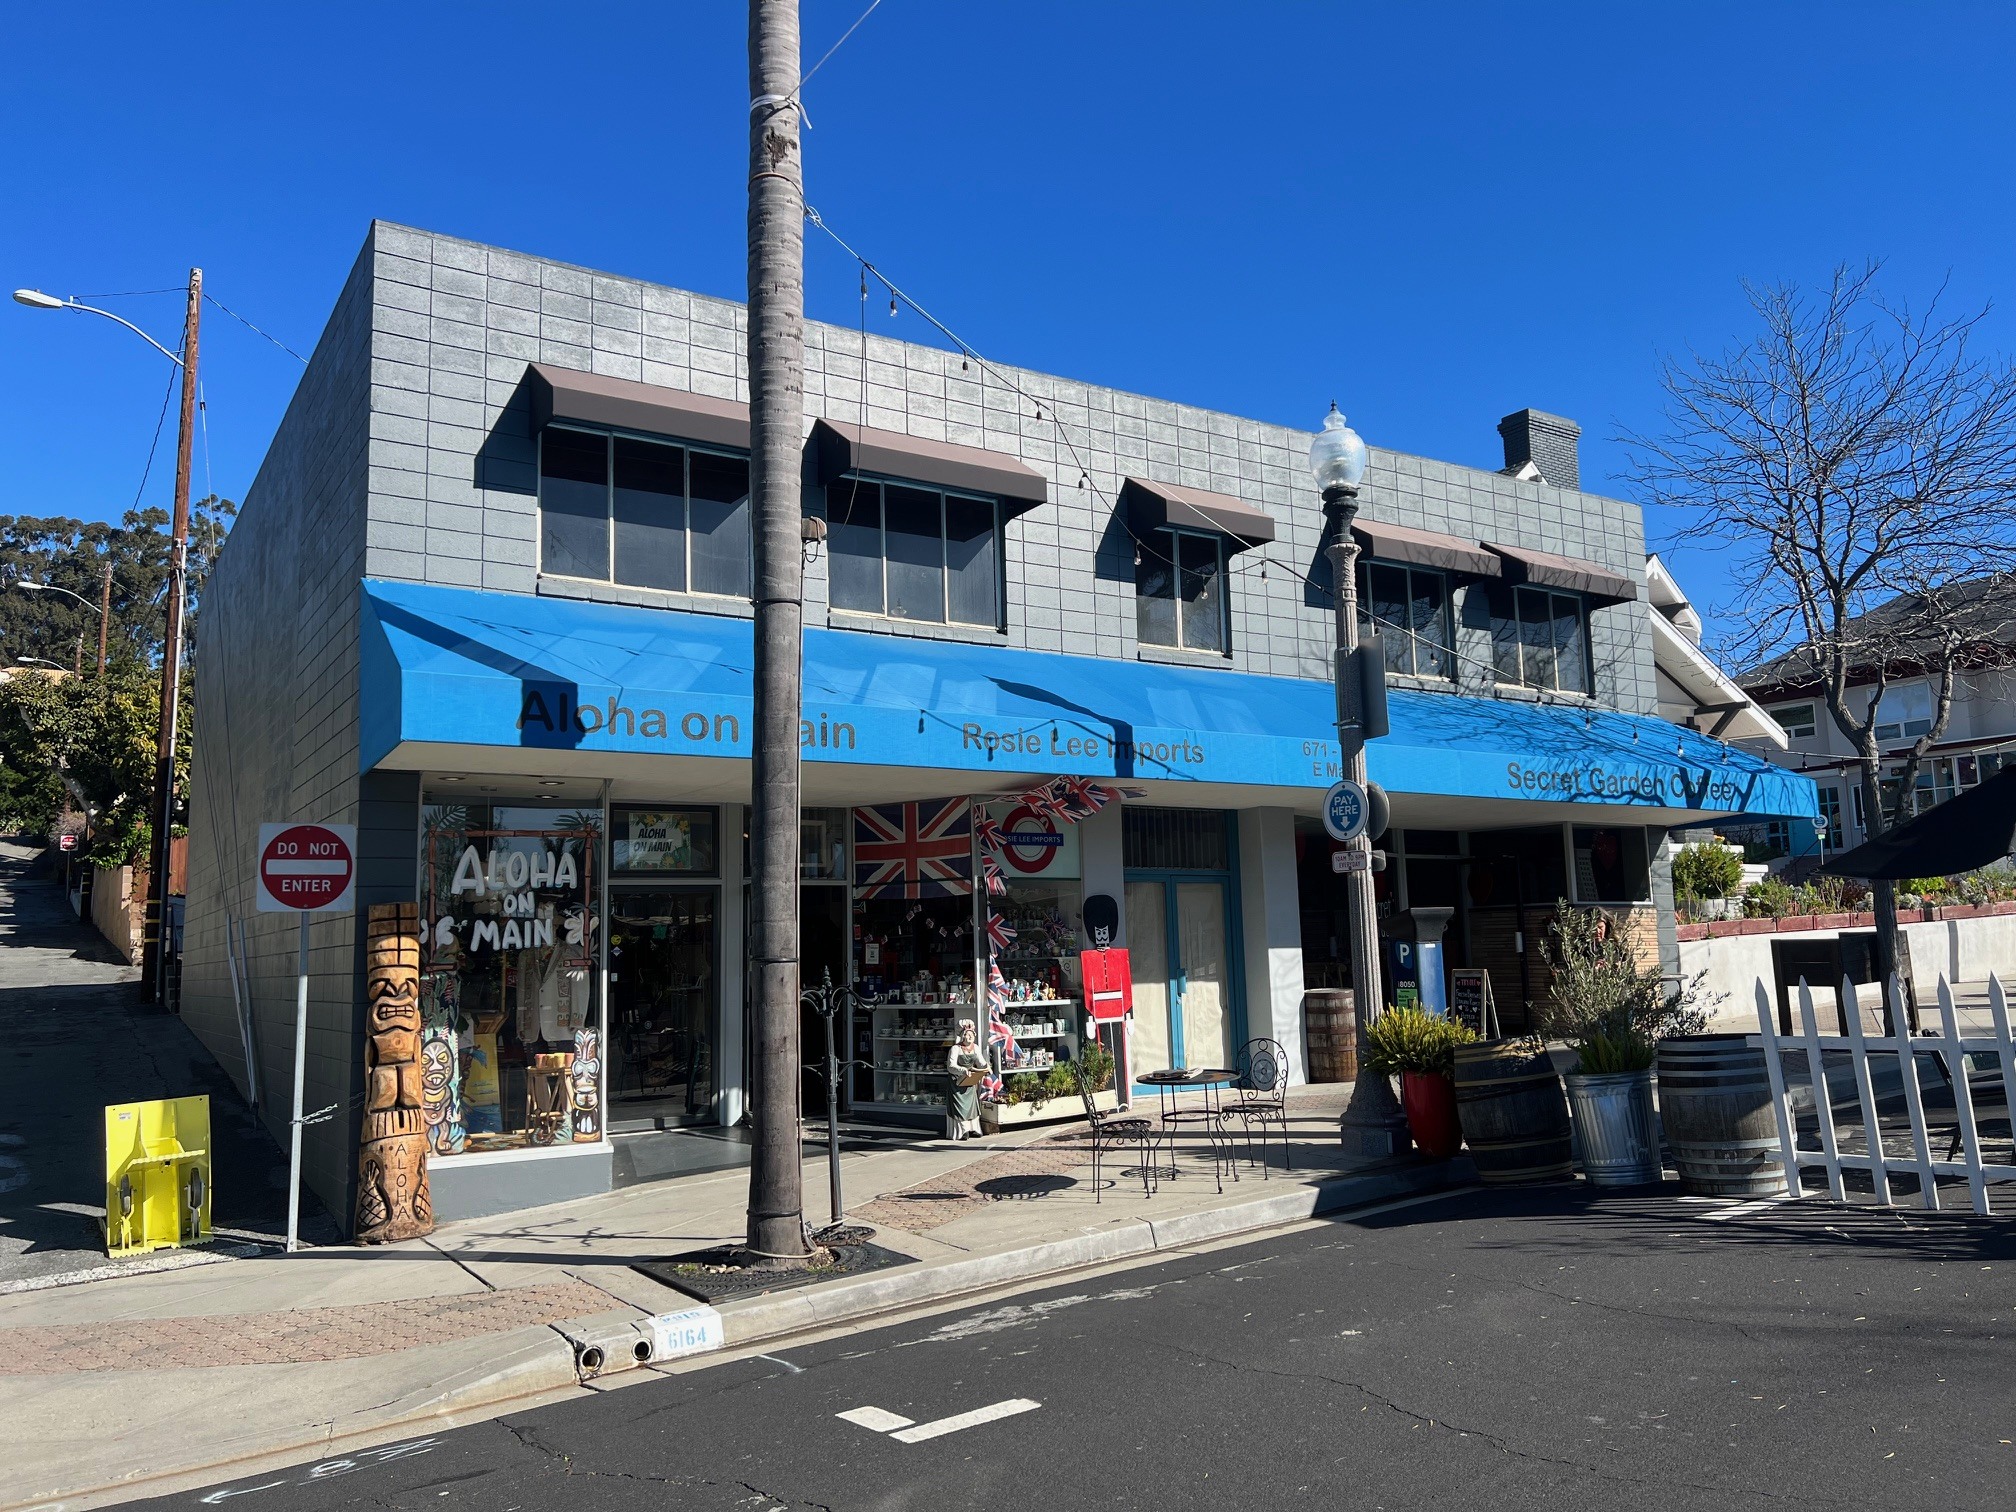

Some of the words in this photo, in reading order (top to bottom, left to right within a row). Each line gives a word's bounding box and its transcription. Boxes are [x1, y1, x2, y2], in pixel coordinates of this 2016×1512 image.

[516, 690, 667, 739] Aloha
[682, 712, 738, 742] on
[801, 712, 855, 749] ain
[963, 723, 1041, 754] Rosie
[1051, 729, 1098, 757] Lee
[1108, 733, 1204, 766] Imports
[1303, 741, 1327, 757] 671
[1313, 762, 1322, 776] E
[1507, 762, 1582, 794] Secret
[1589, 767, 1665, 797] Garden
[1671, 773, 1733, 801] Coffee
[1331, 804, 1358, 817] HERE
[1334, 795, 1355, 806] PAY
[638, 828, 667, 839] ALOHA
[277, 842, 298, 855] DO
[309, 842, 339, 855] NOT
[634, 841, 646, 852] ON
[648, 841, 672, 852] MAIN
[451, 844, 578, 897] ALOHA
[281, 879, 331, 892] ENTER
[503, 891, 535, 914] ON
[470, 918, 554, 952] MAIN
[1400, 943, 1410, 964] P
[395, 1143, 410, 1221] ALOHA
[668, 1326, 706, 1350] 6164
